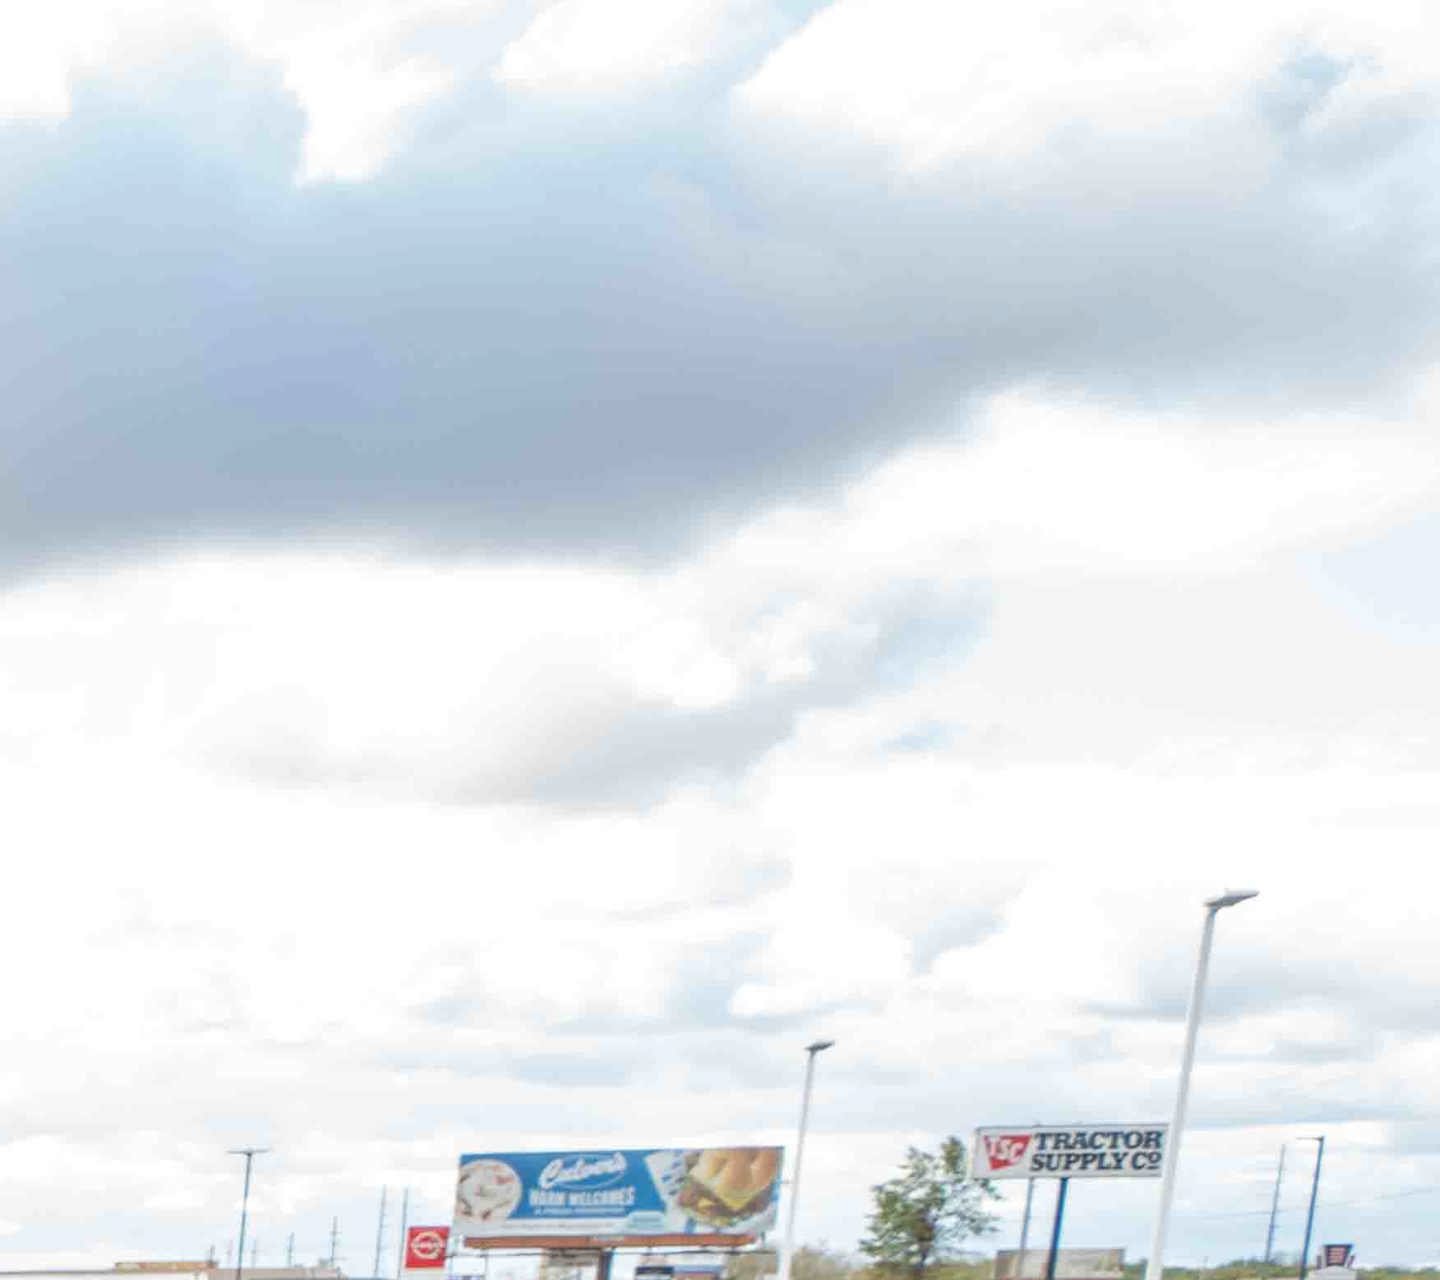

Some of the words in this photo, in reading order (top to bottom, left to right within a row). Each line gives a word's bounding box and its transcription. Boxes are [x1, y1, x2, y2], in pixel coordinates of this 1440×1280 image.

[985, 1135, 1025, 1164] TSC
[1032, 1131, 1163, 1151] TRACTOR
[1029, 1151, 1127, 1171] SUPPLY
